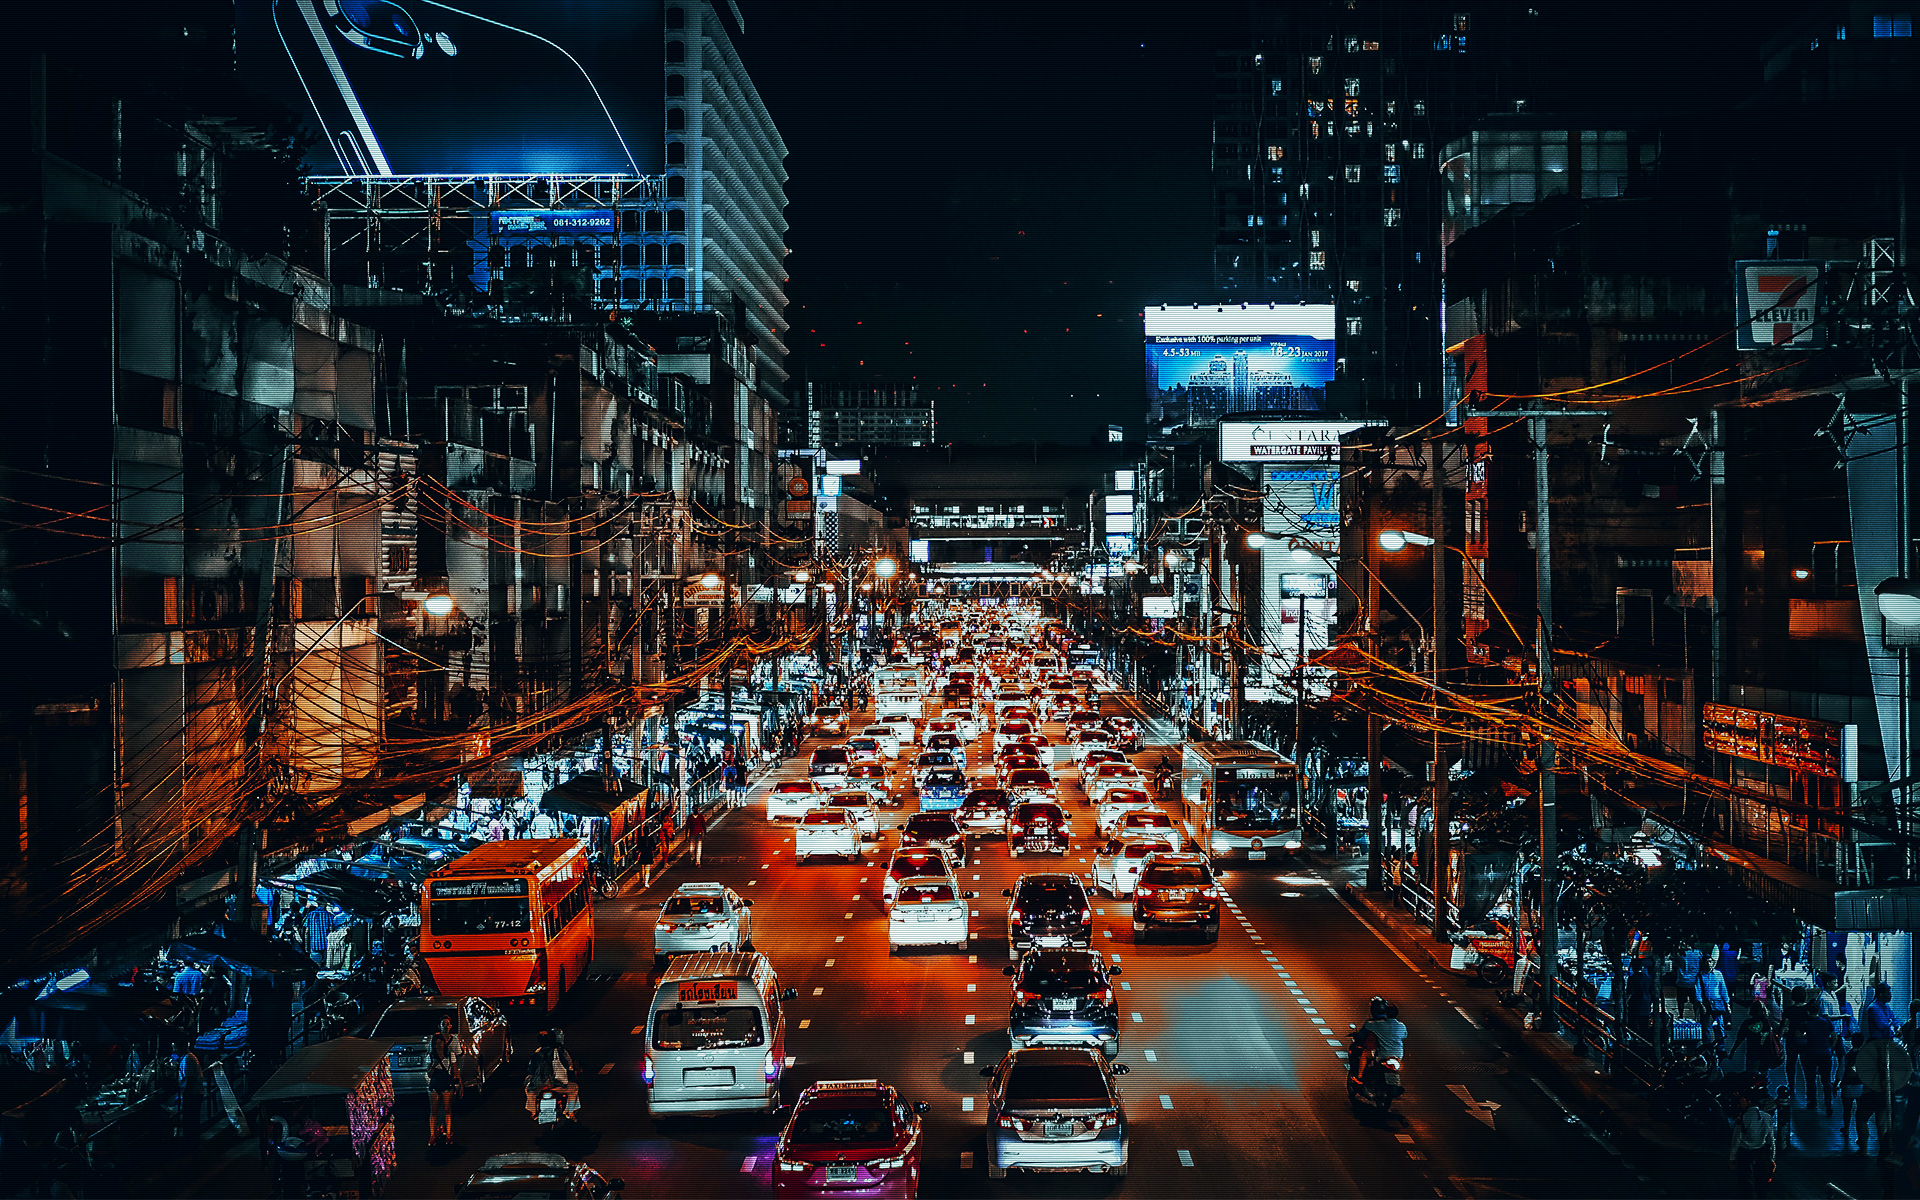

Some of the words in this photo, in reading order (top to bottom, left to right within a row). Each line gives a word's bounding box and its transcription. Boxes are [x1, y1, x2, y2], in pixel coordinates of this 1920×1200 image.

[553, 218, 611, 227] 081-312-9262
[1155, 335, 1183, 344] Exclusive
[1197, 335, 1216, 343] 100%
[1216, 335, 1239, 345] parking
[1239, 336, 1249, 345] per
[1249, 335, 1262, 343] unit
[1162, 348, 1190, 357] 4.5-53
[1270, 346, 1301, 358] 18-23
[1301, 350, 1313, 358] JAN
[1314, 350, 1329, 358] 2017
[1253, 446, 1301, 455] WATERGATE
[494, 920, 521, 929] 77-12
